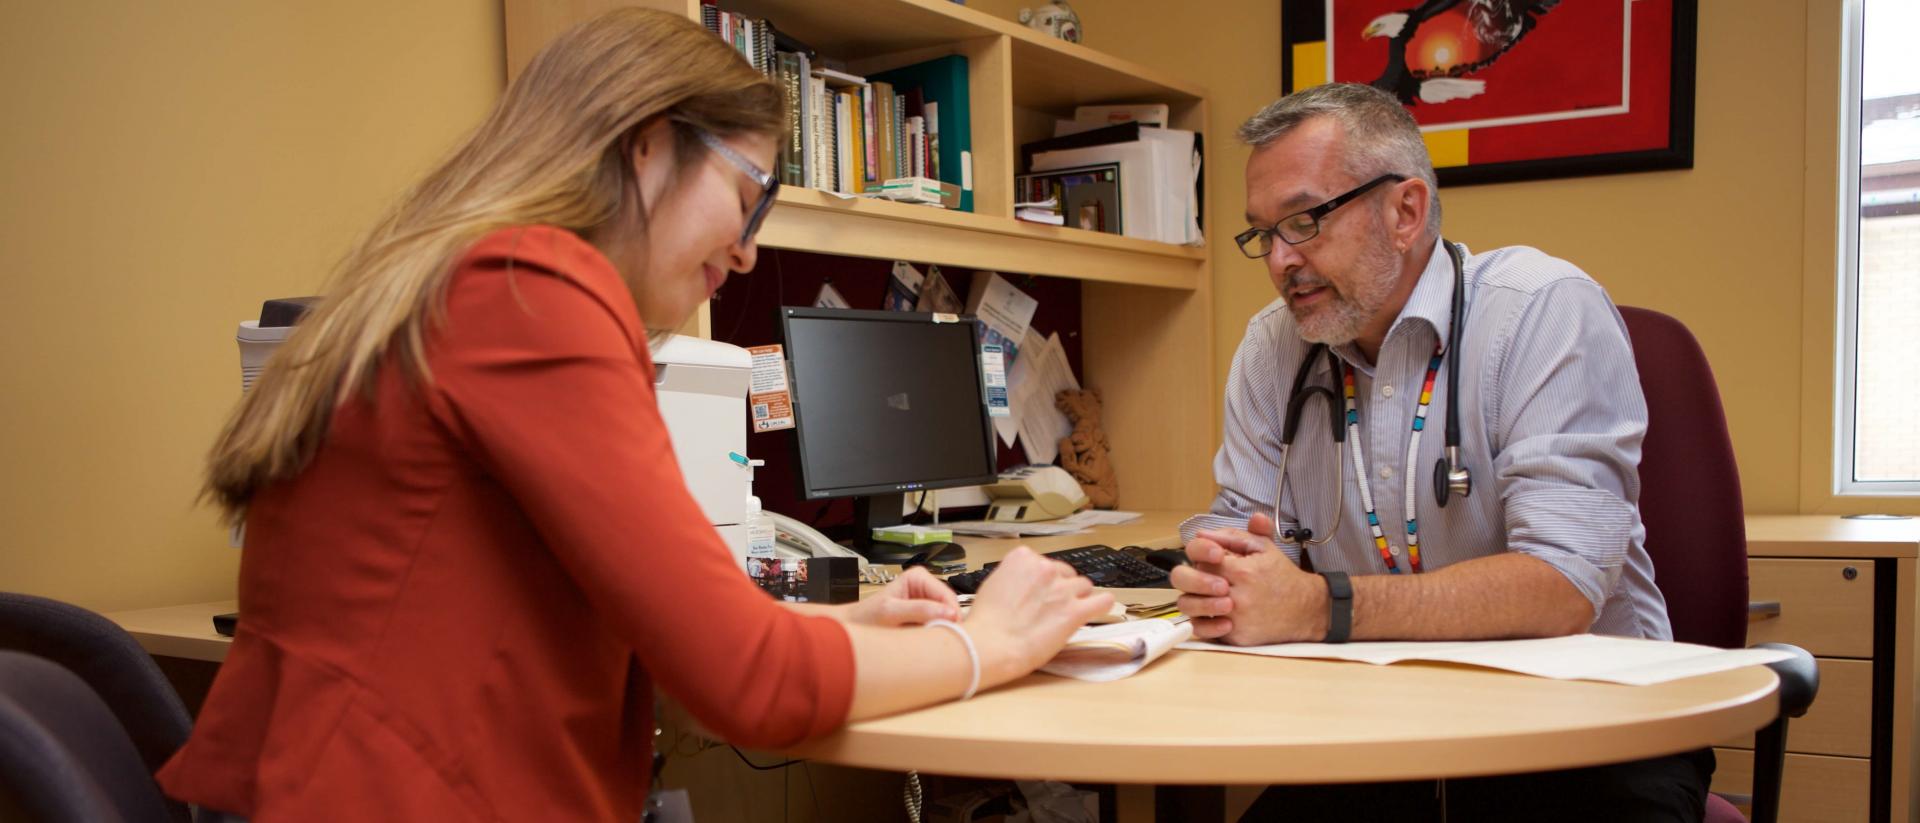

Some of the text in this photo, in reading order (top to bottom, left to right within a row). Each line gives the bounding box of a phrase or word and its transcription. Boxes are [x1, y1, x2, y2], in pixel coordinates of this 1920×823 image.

[784, 71, 792, 81] of
[791, 74, 800, 105] Muir's
[793, 108, 802, 153] Textbook
